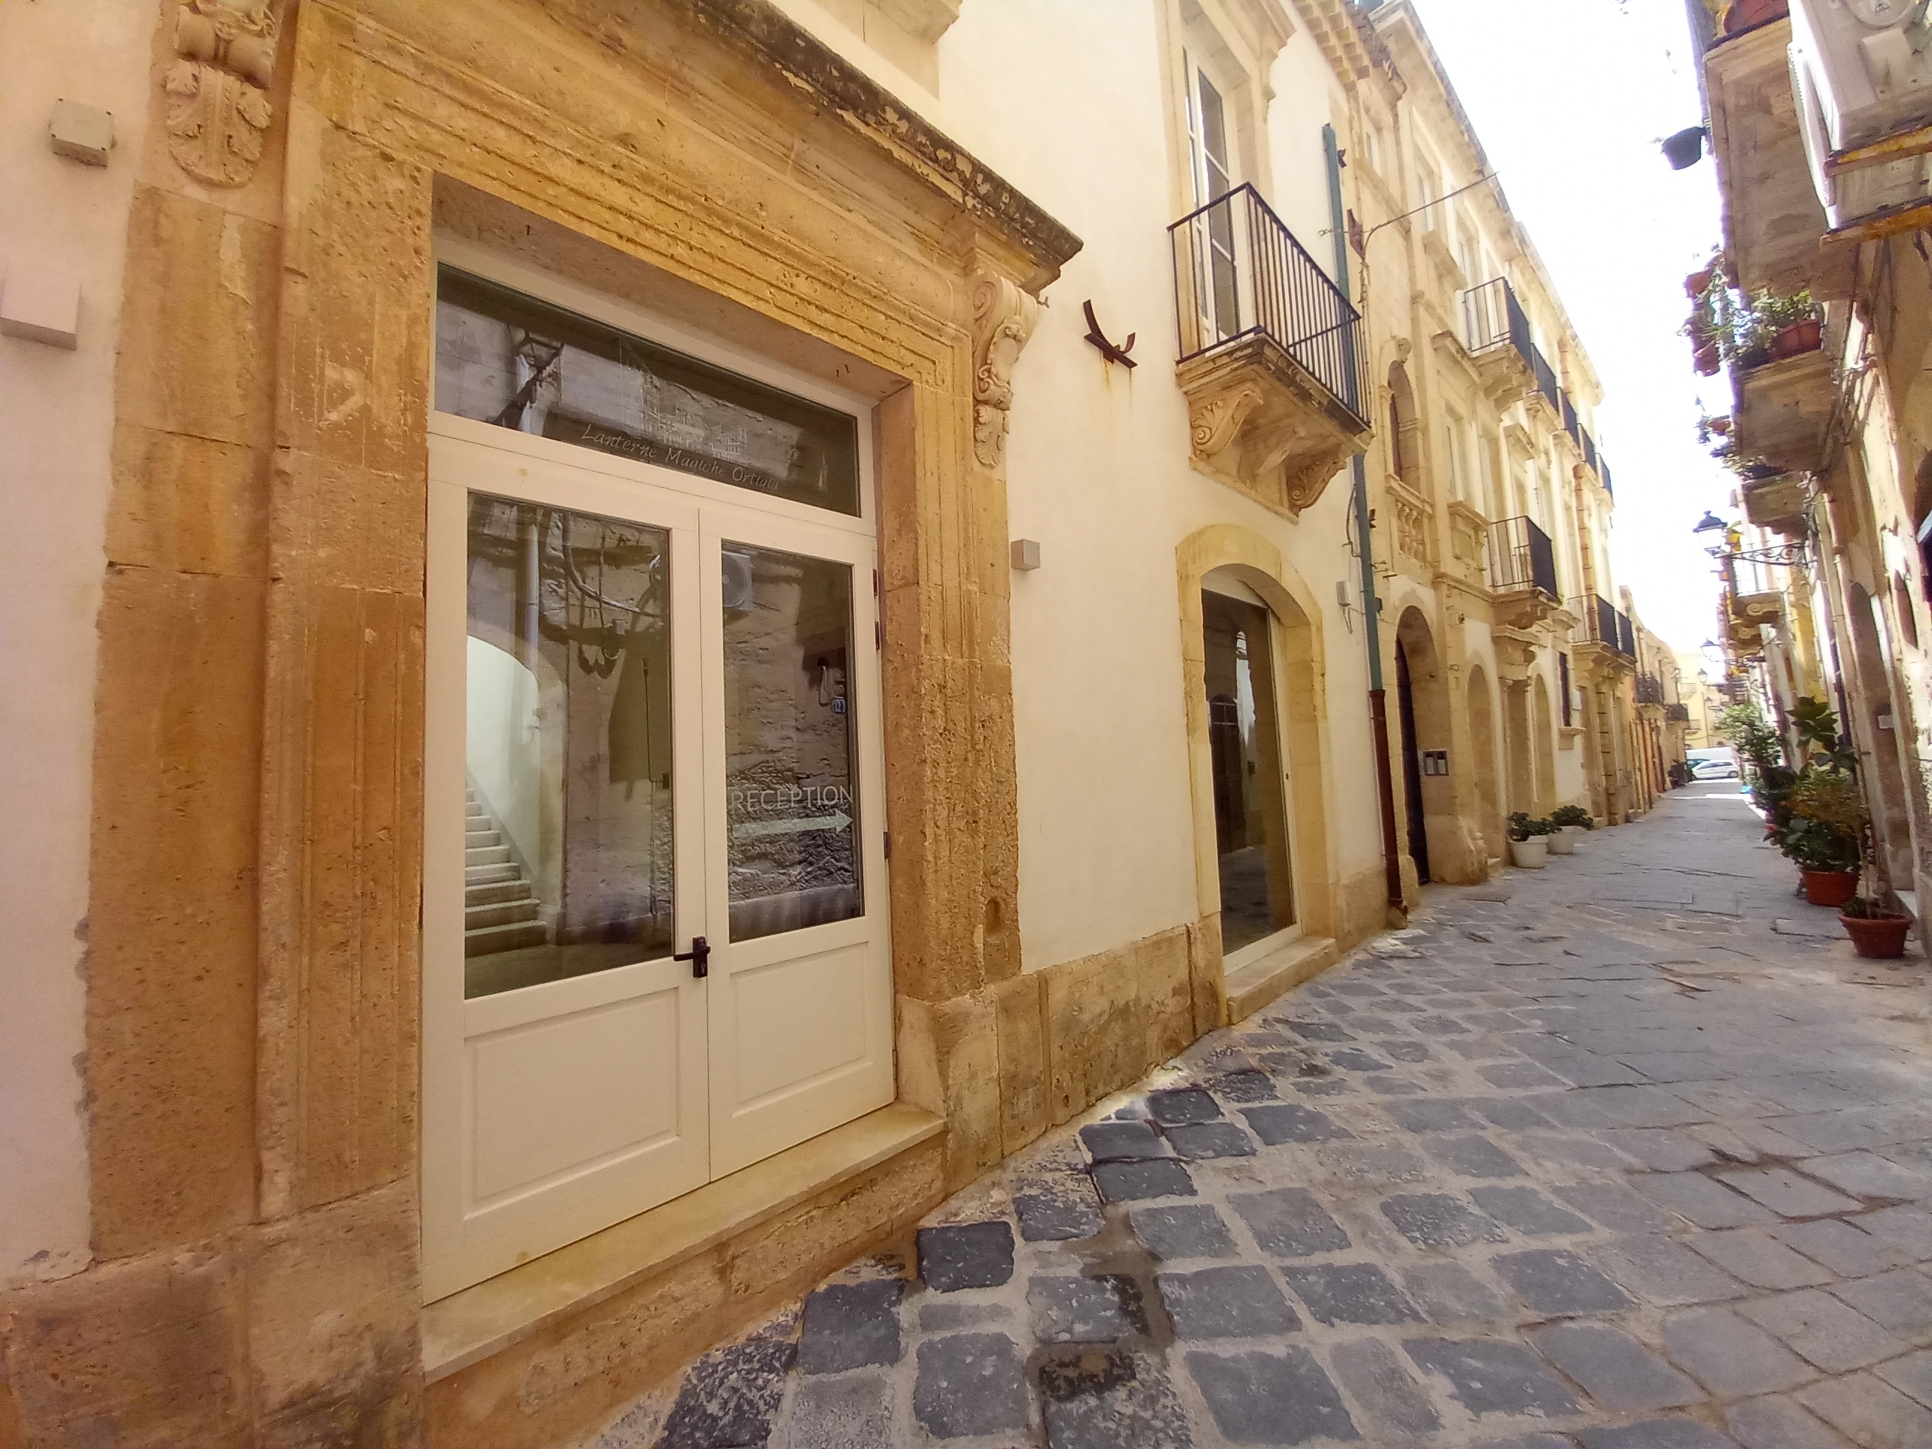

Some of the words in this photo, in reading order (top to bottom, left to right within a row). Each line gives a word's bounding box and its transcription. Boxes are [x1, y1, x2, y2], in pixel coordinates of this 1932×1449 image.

[581, 423, 657, 458] Lanterne
[664, 442, 725, 476] Magiche
[732, 466, 779, 492] Ortigia
[731, 785, 853, 814] RECEPTION
